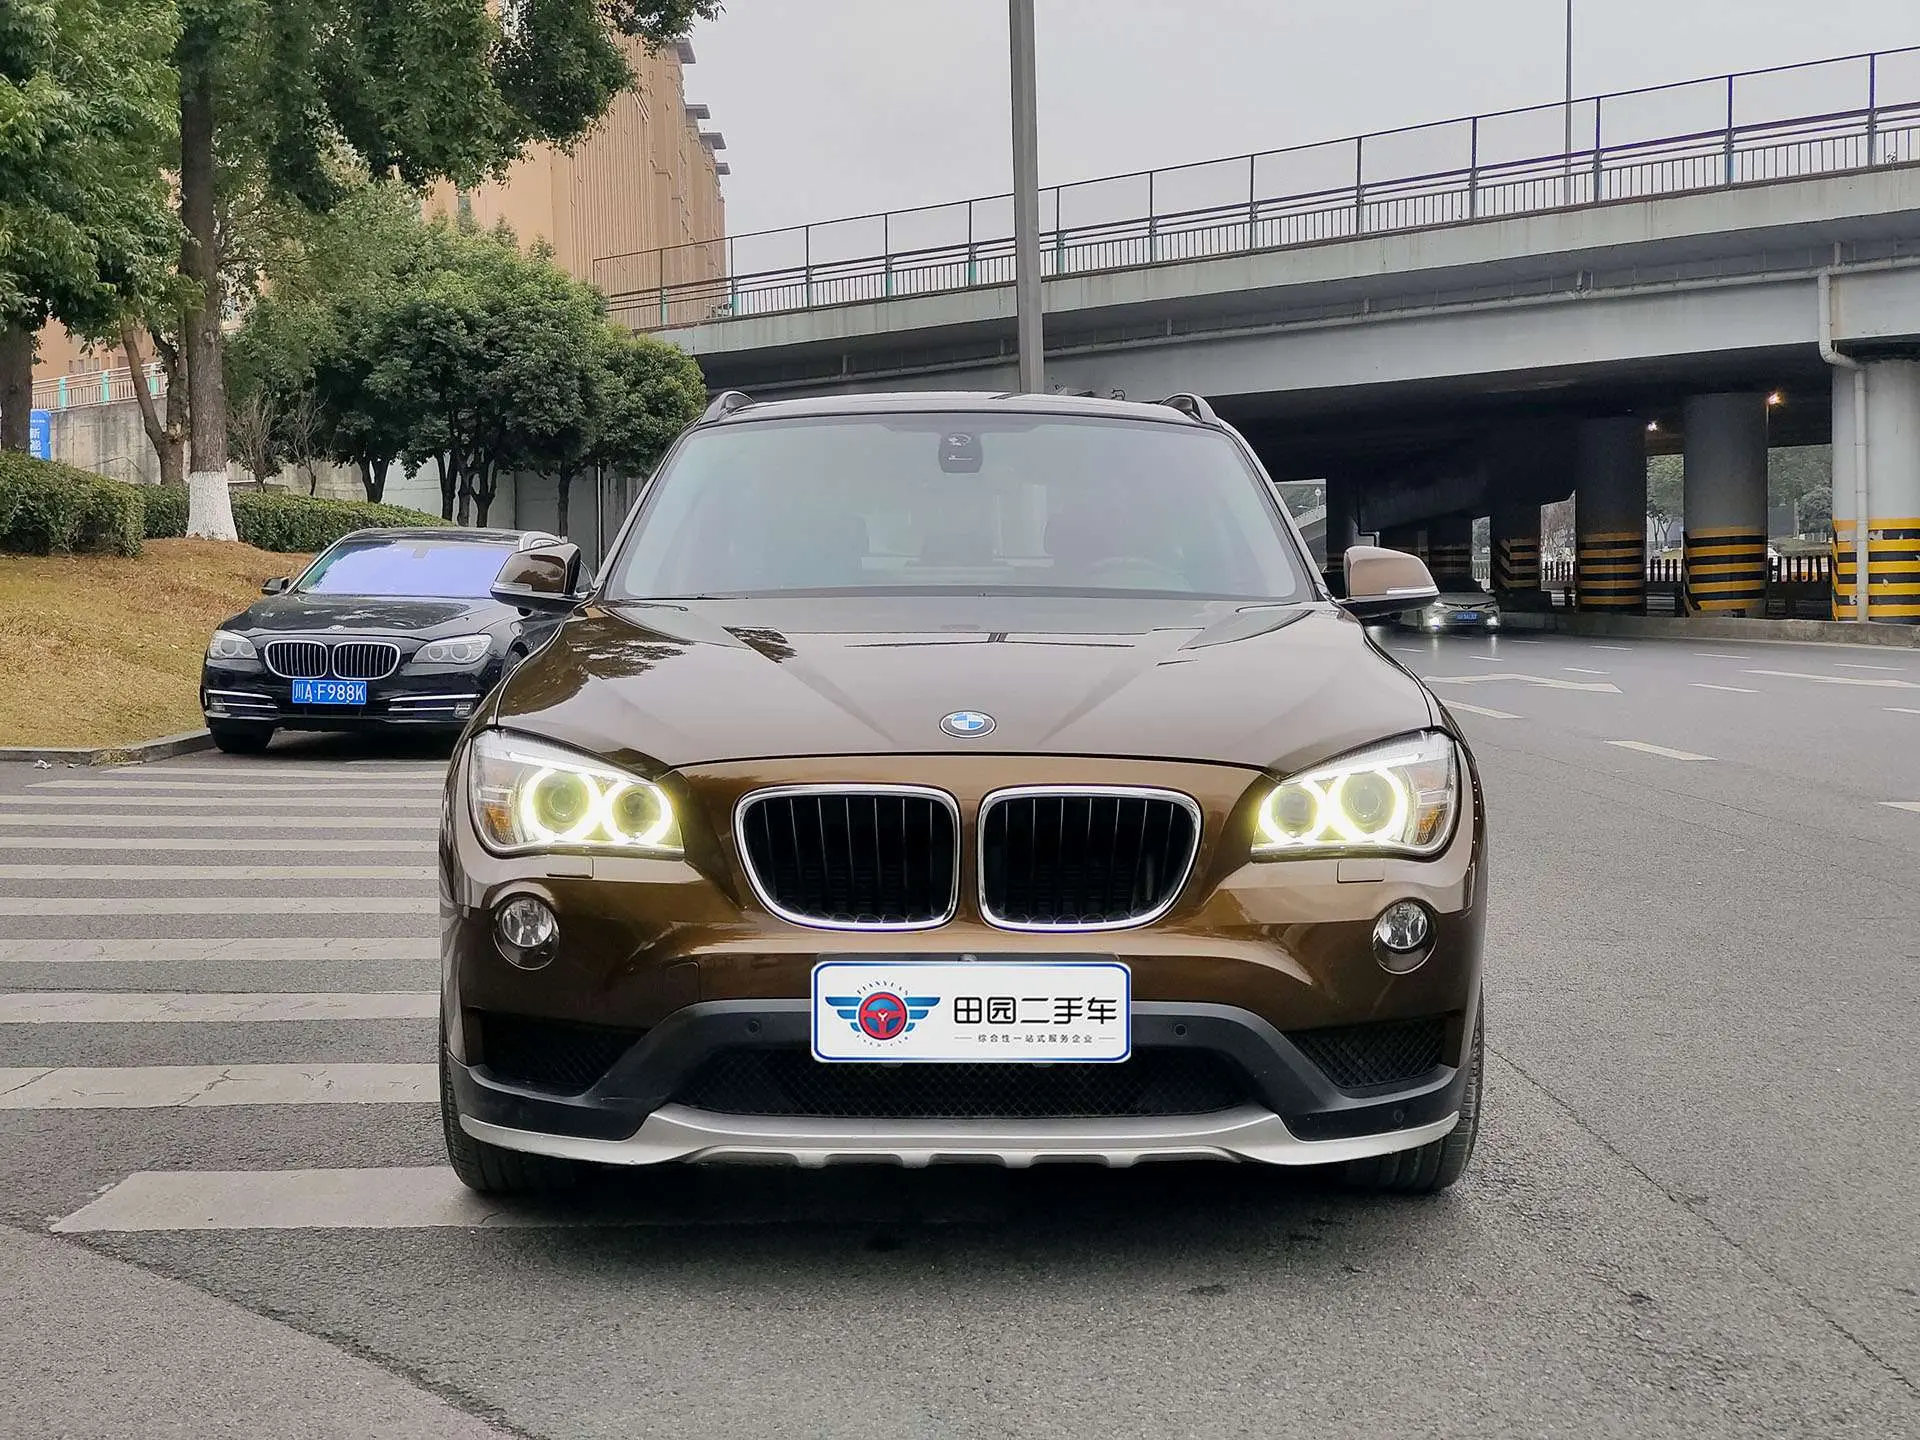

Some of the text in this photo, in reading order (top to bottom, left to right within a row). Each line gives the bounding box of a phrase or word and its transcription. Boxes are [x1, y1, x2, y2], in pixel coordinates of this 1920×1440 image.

[953, 996, 1118, 1025] 田园二手车
[977, 1033, 1093, 1044] 综合性一站式服务企业
